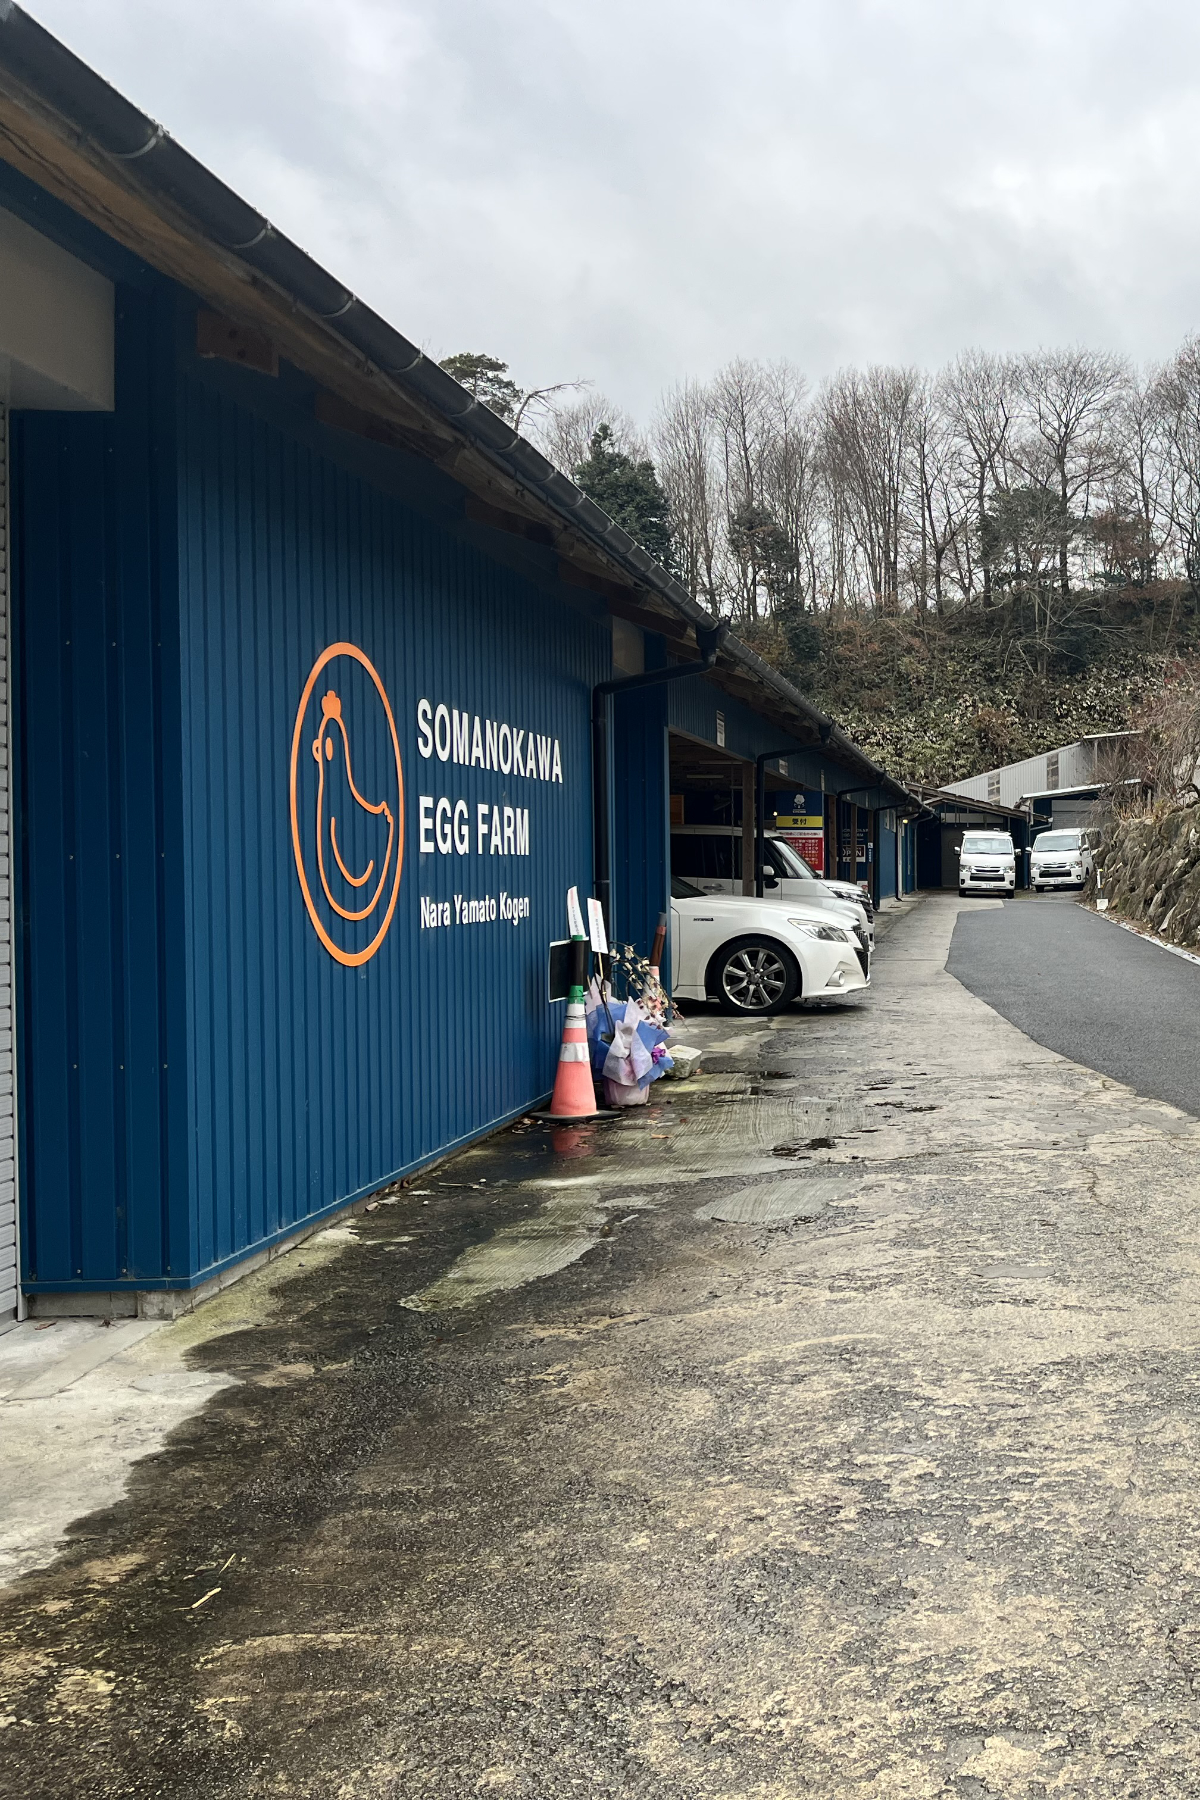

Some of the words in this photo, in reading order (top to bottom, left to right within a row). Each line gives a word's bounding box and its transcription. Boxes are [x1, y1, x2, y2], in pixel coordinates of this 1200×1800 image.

[417, 698, 563, 783] SOMANOKAWA
[419, 796, 470, 856] EGG
[477, 803, 530, 856] FARM
[420, 896, 451, 929] Nara
[453, 894, 497, 925] Yamato
[499, 892, 530, 926] Kogen
